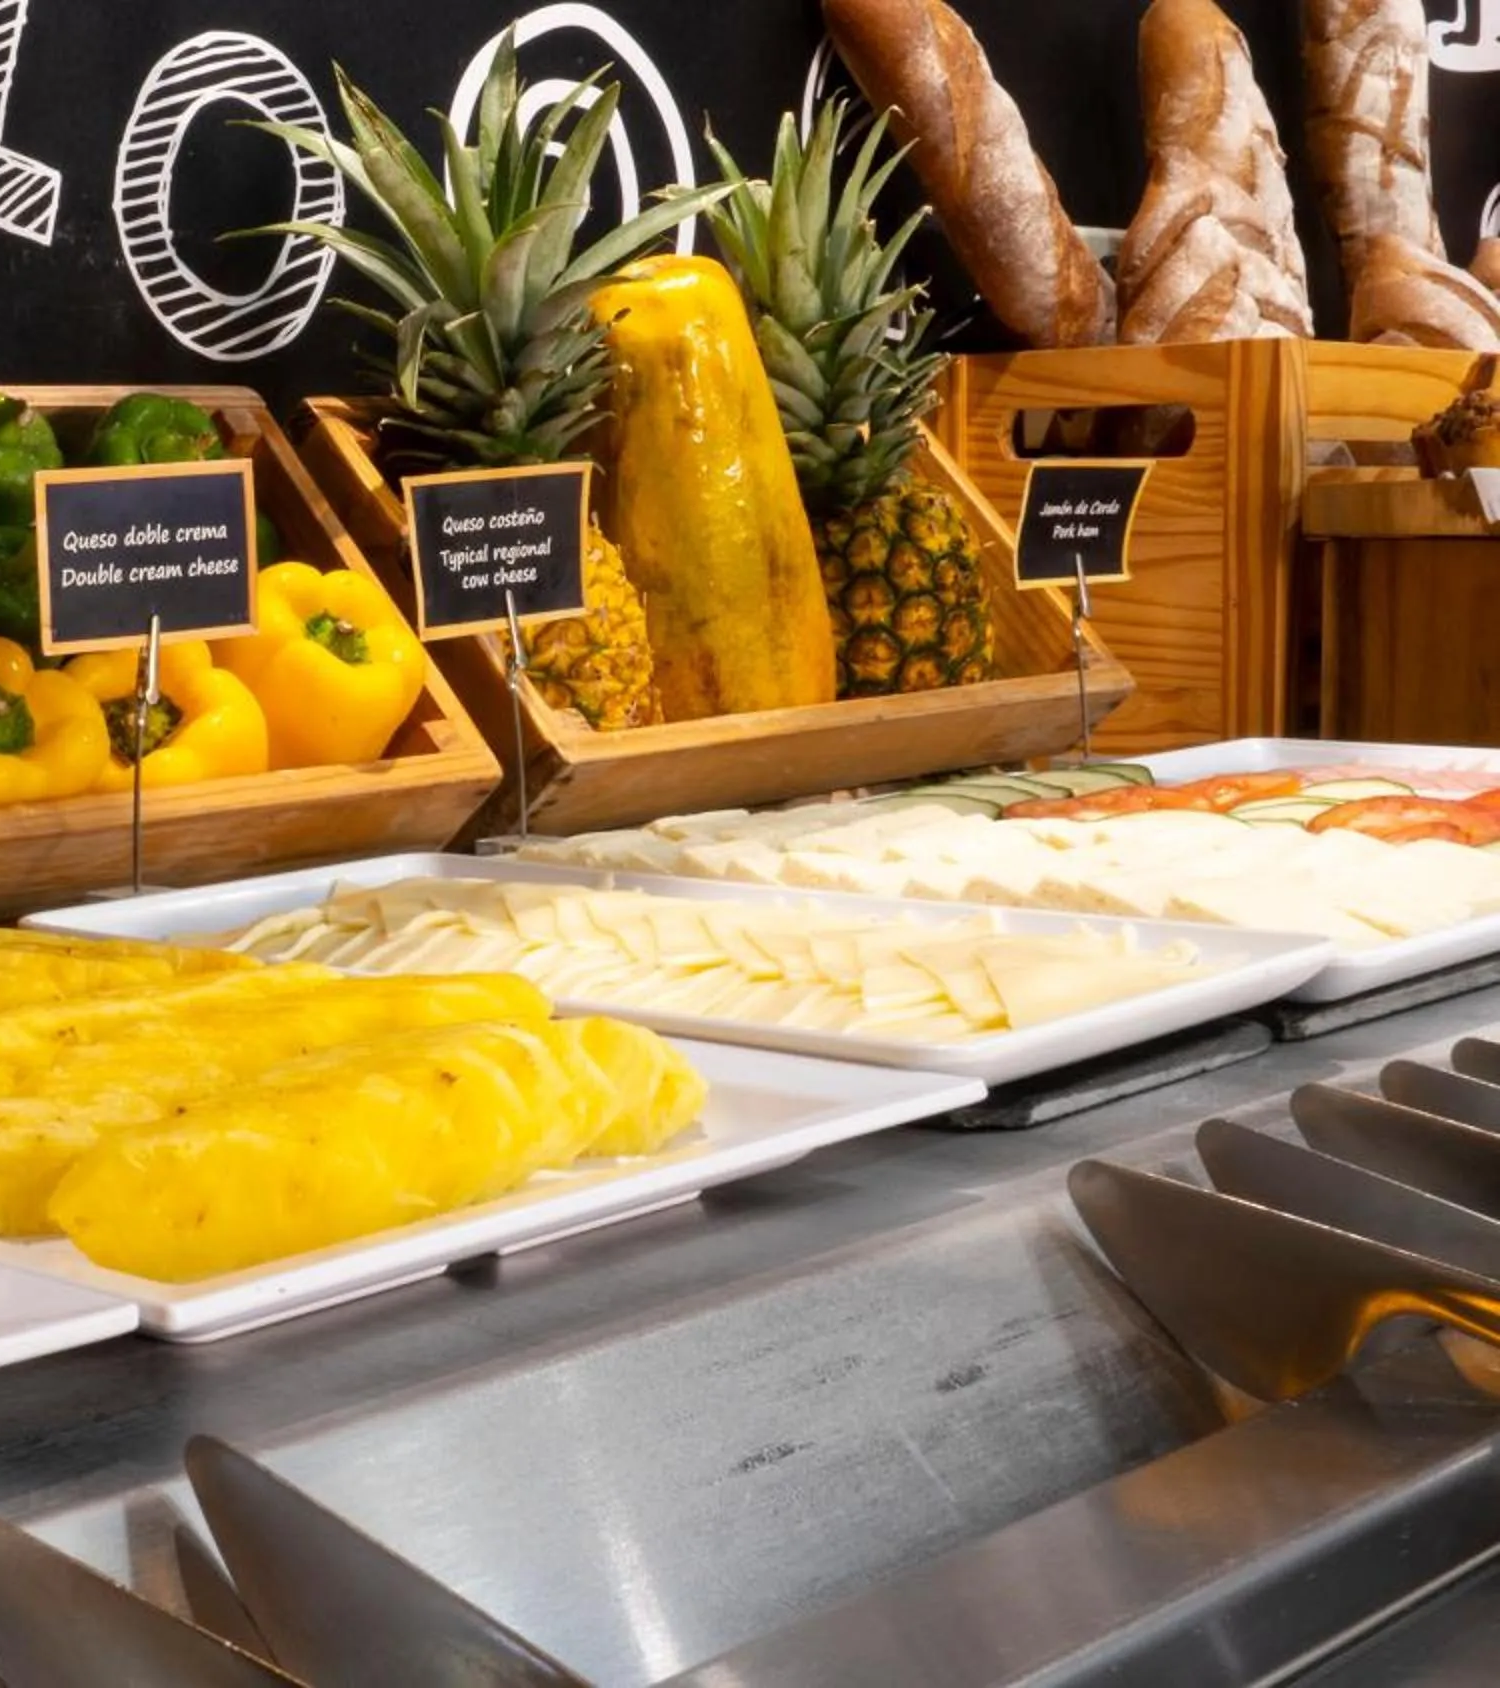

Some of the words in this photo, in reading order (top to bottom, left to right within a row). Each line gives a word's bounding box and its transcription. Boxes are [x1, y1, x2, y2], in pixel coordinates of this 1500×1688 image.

[442, 516, 484, 536] Queso
[489, 507, 545, 529] costeño
[1074, 500, 1089, 515] de
[63, 531, 117, 552] Queso
[124, 523, 170, 546] doble
[175, 524, 228, 543] crema
[1053, 523, 1075, 539] Pork
[1077, 523, 1099, 537] ham
[439, 543, 488, 571] Typical
[493, 536, 552, 564] regional
[61, 562, 124, 588] Double
[129, 563, 183, 583] cream
[187, 554, 239, 577] cheese
[462, 574, 489, 589] cow
[493, 566, 538, 585] cheese
